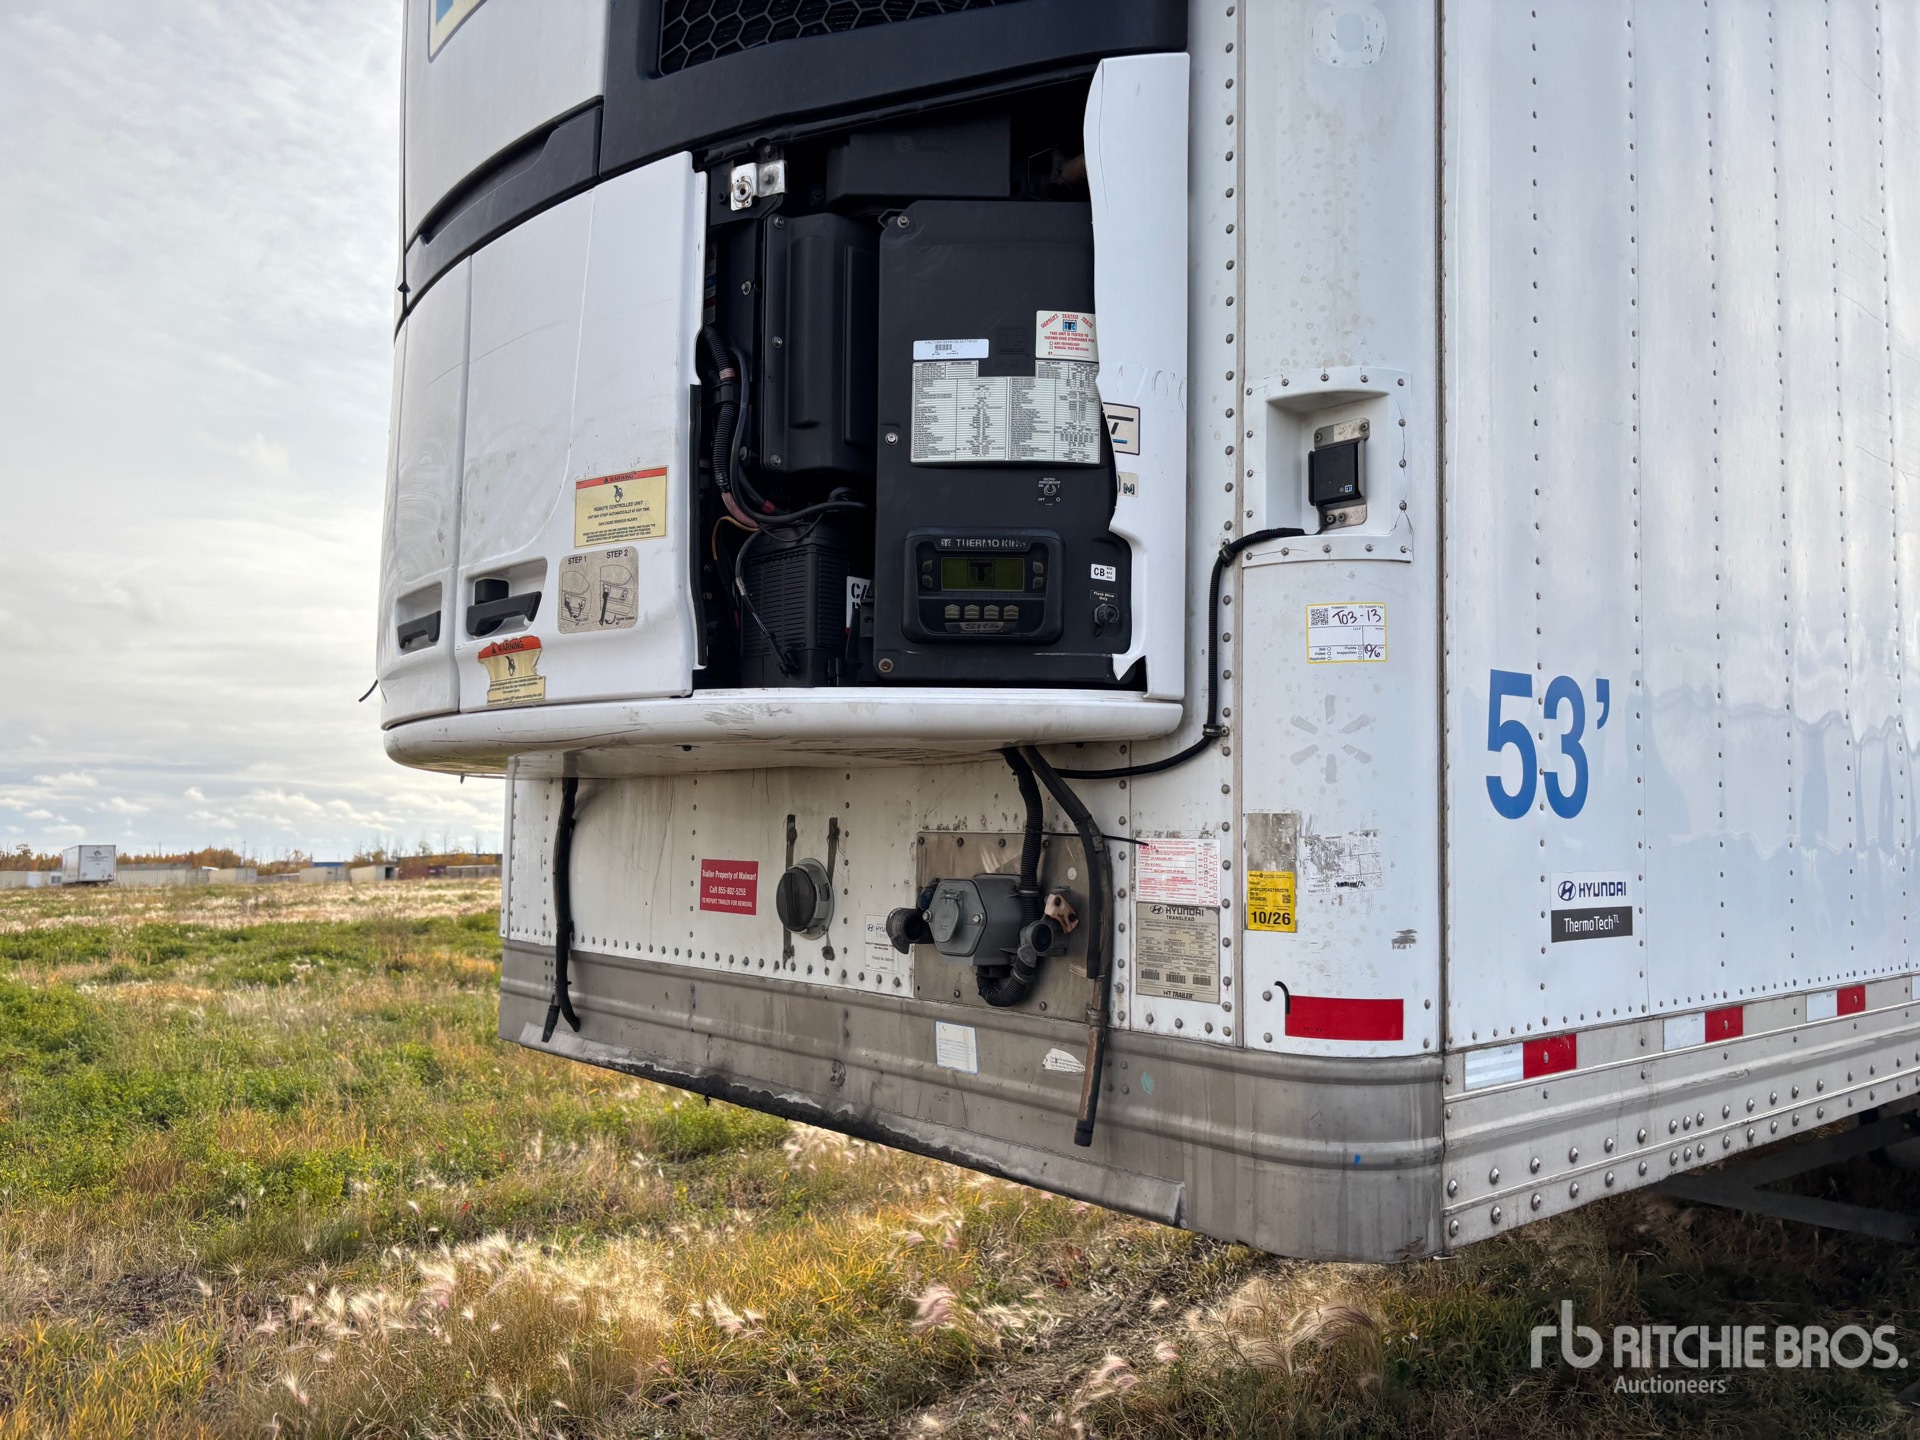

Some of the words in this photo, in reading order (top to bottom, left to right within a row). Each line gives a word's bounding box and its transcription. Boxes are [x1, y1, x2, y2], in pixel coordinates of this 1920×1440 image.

[956, 539, 1000, 548] THERMO
[606, 550, 622, 559] STEP
[568, 556, 582, 564] STEP
[1094, 567, 1104, 576] CB
[498, 640, 524, 652] WARNING
[715, 870, 733, 880] Property
[739, 872, 756, 880] Walmart
[1579, 882, 1626, 898] HYUNDAI
[1166, 907, 1204, 916] HYUNDAI
[1251, 912, 1291, 926] 10/26
